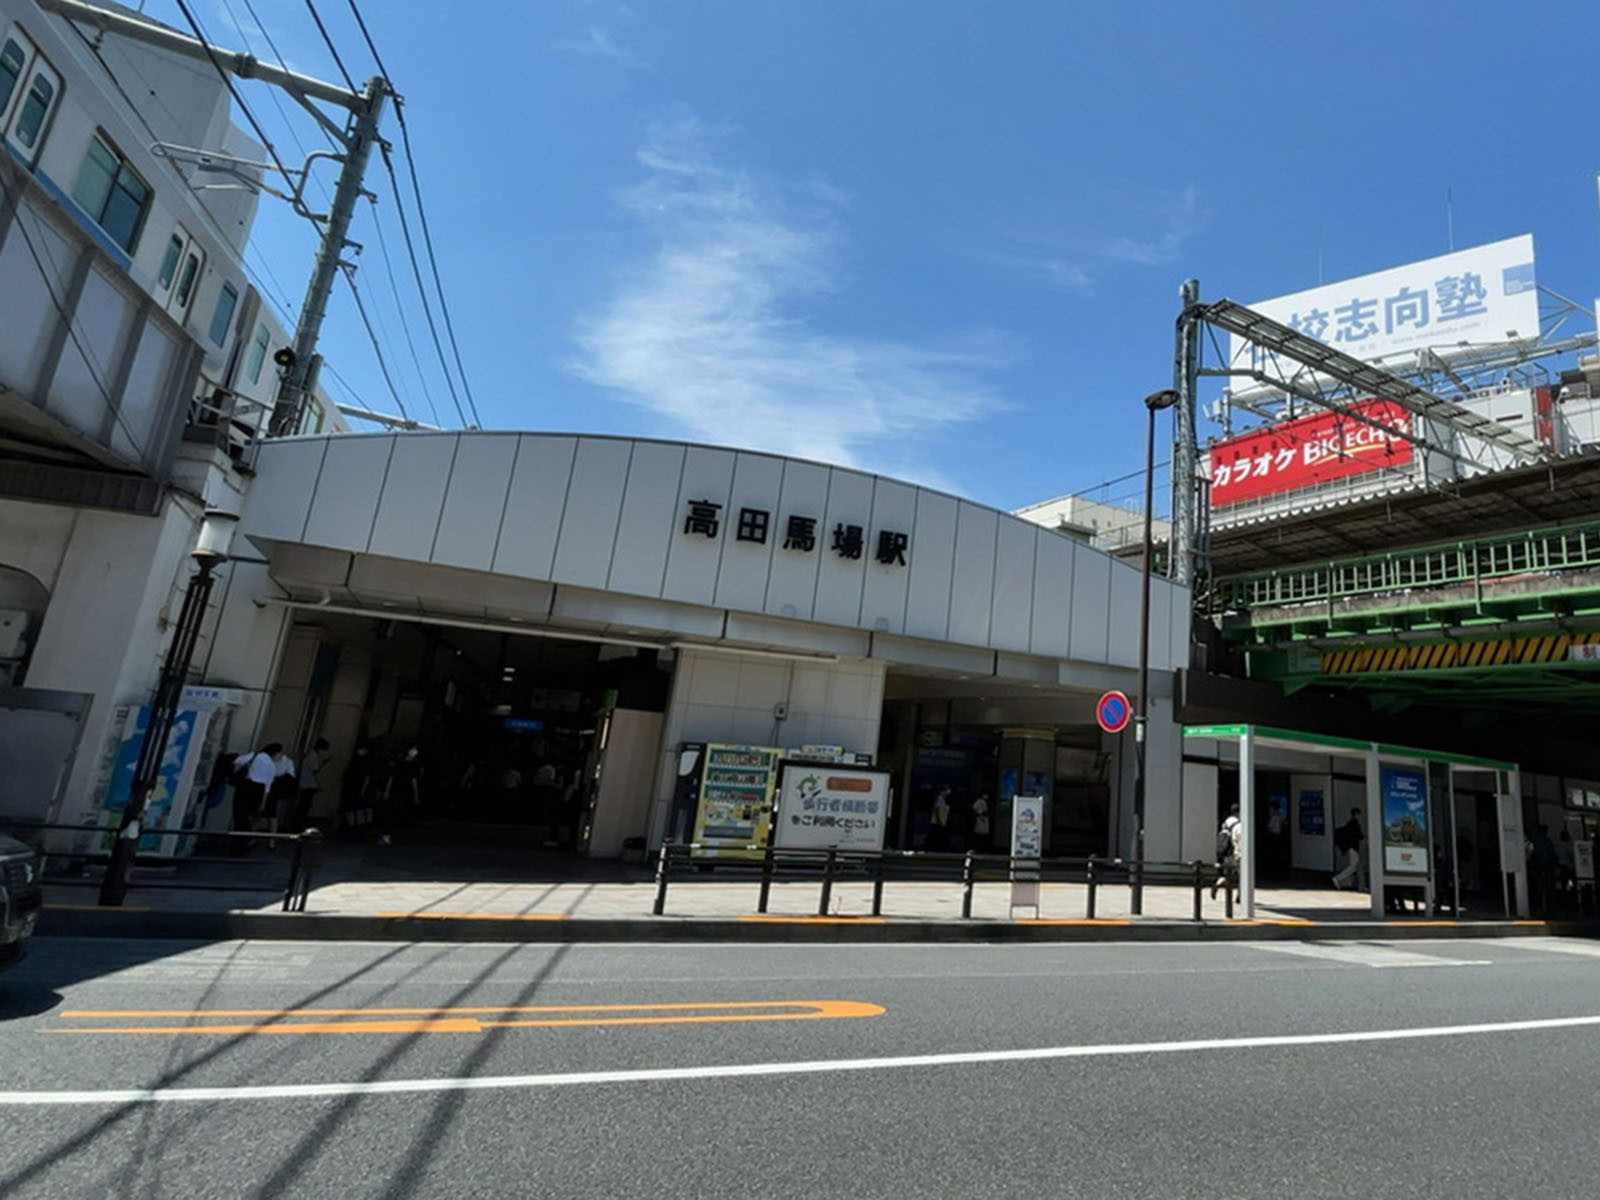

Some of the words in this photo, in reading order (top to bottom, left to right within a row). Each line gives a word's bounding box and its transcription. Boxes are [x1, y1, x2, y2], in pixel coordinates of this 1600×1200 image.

[1243, 271, 1488, 366] 校志向塾
[1212, 447, 1298, 488] カラオケ
[1303, 435, 1342, 465] BIG
[1345, 418, 1408, 448] ECHO
[683, 499, 909, 567] 高田馬場駅
